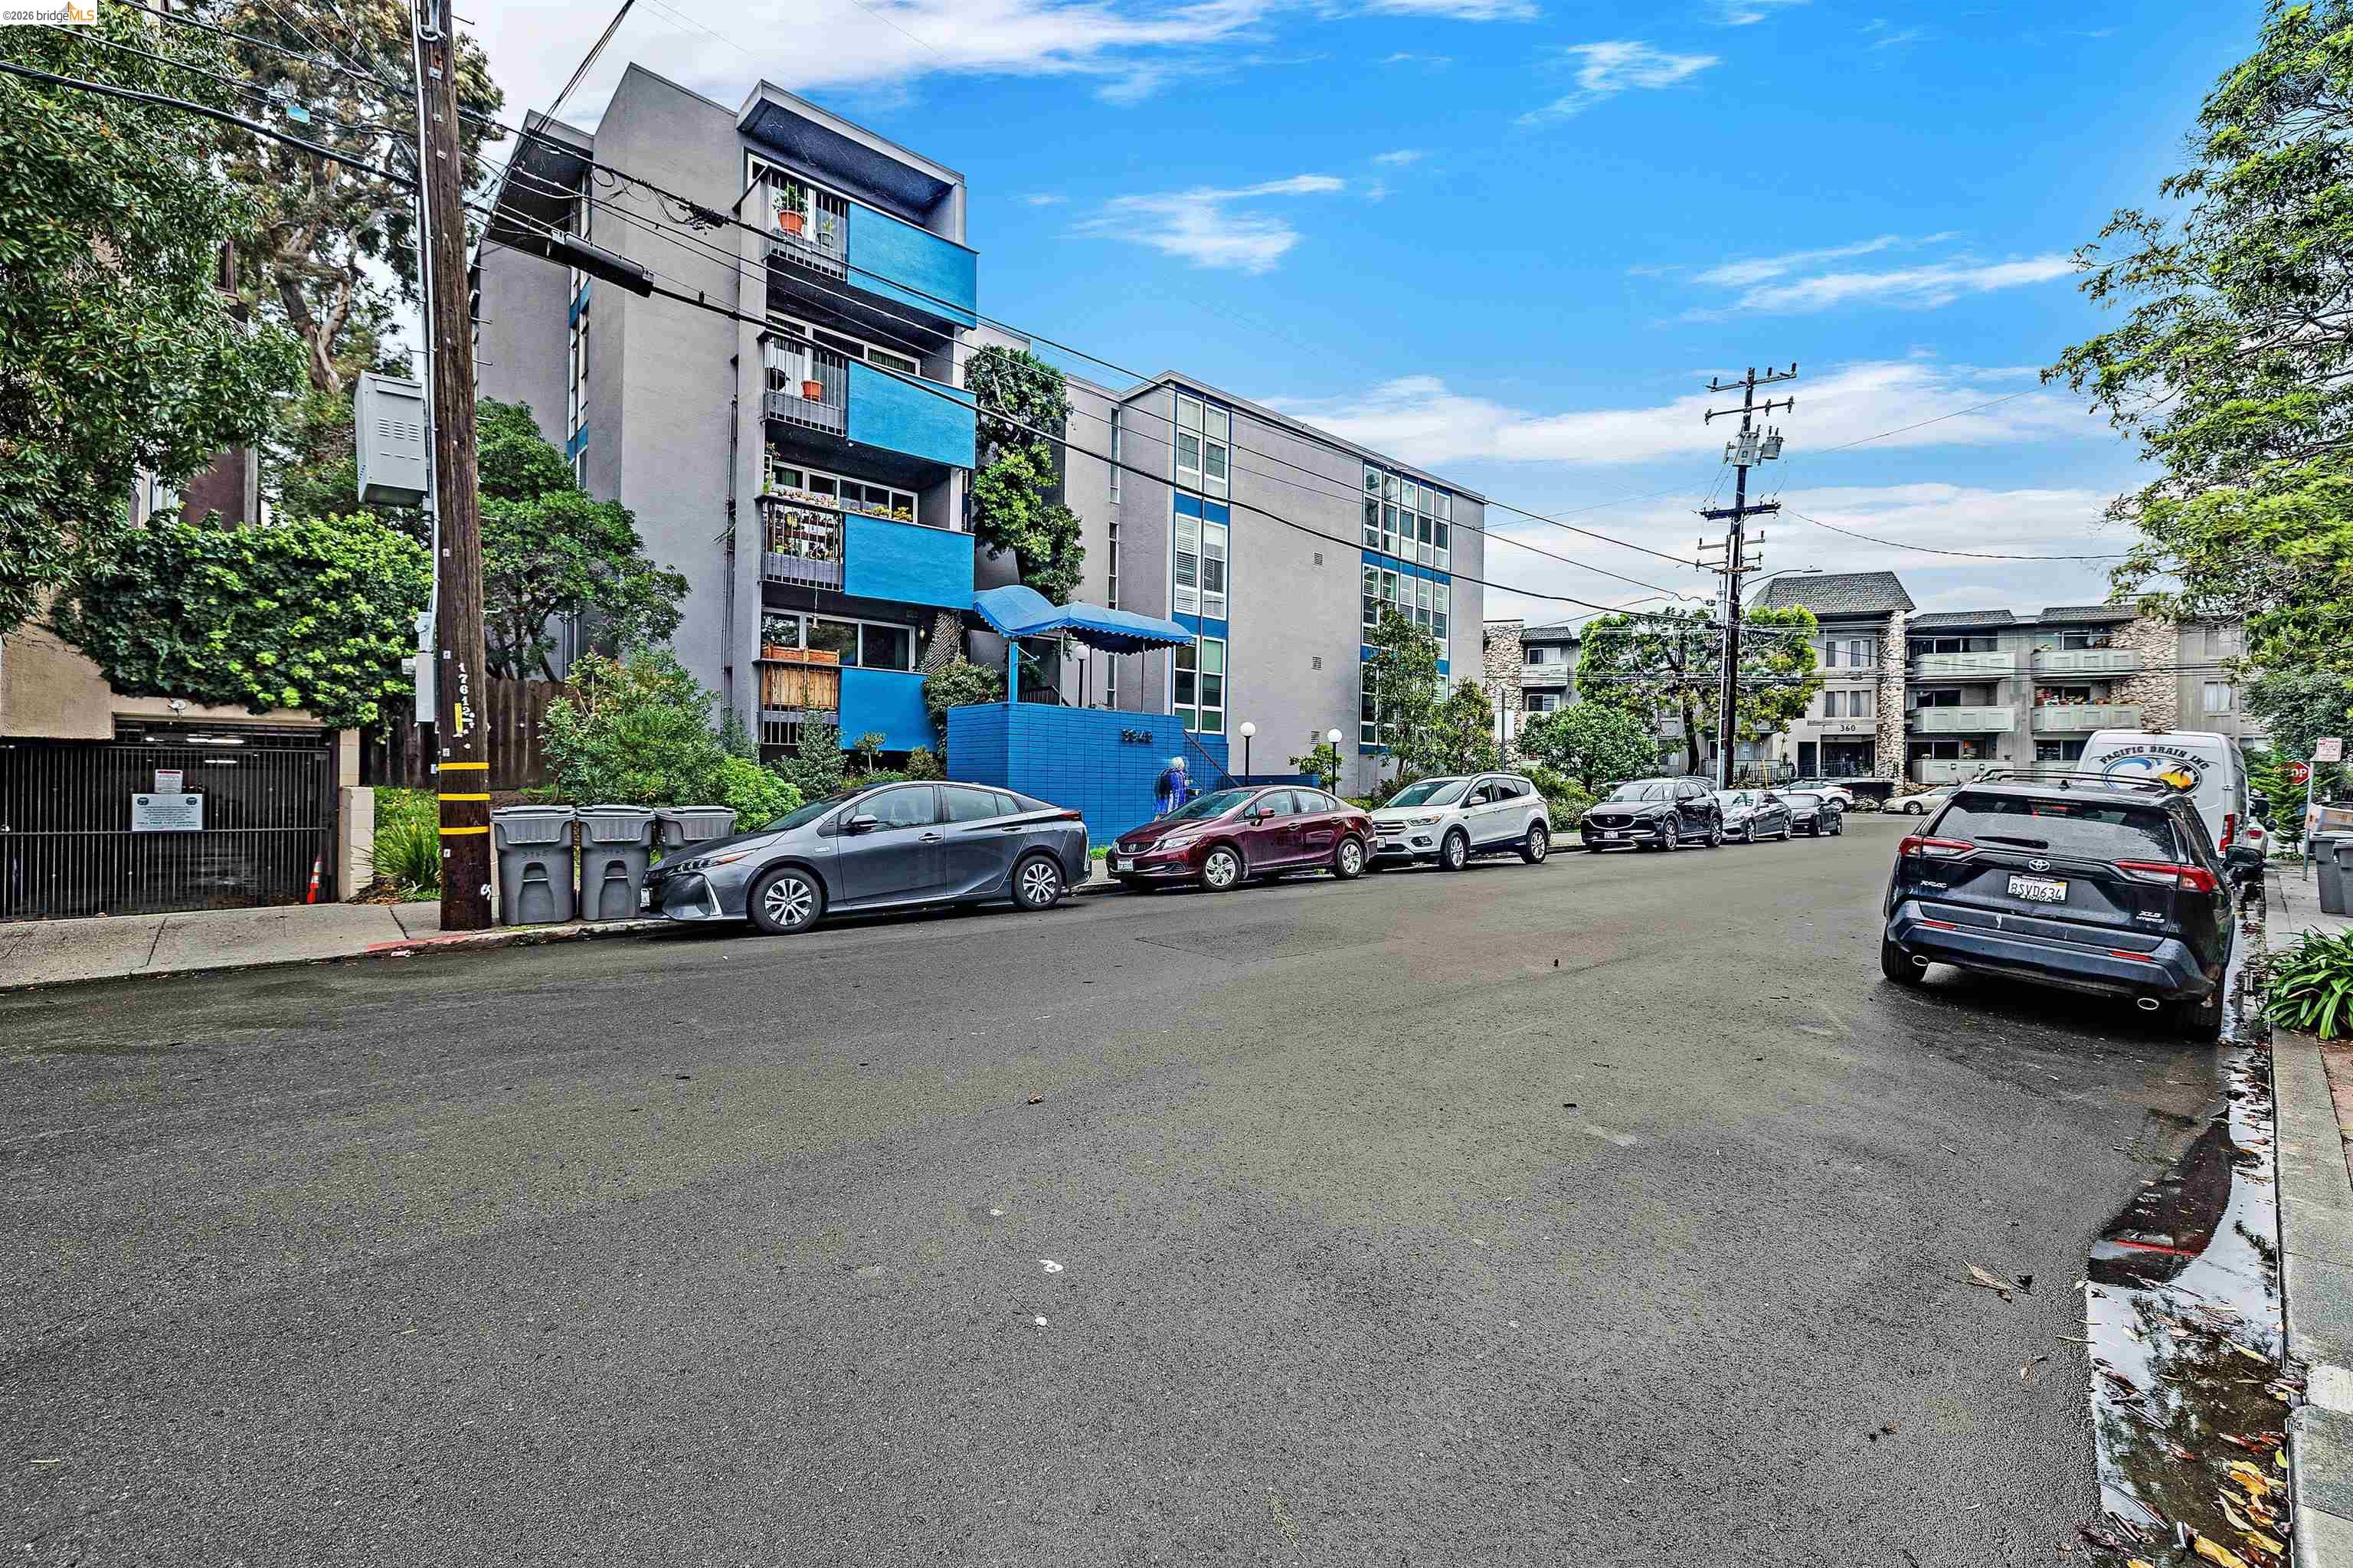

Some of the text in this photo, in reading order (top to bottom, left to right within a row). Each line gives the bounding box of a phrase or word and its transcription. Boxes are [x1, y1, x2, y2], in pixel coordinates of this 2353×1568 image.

[1840, 724, 1857, 732] 360
[2099, 745, 2211, 770] PACIFIC DRAIN INC
[2010, 882, 2063, 900] 8SVD634
